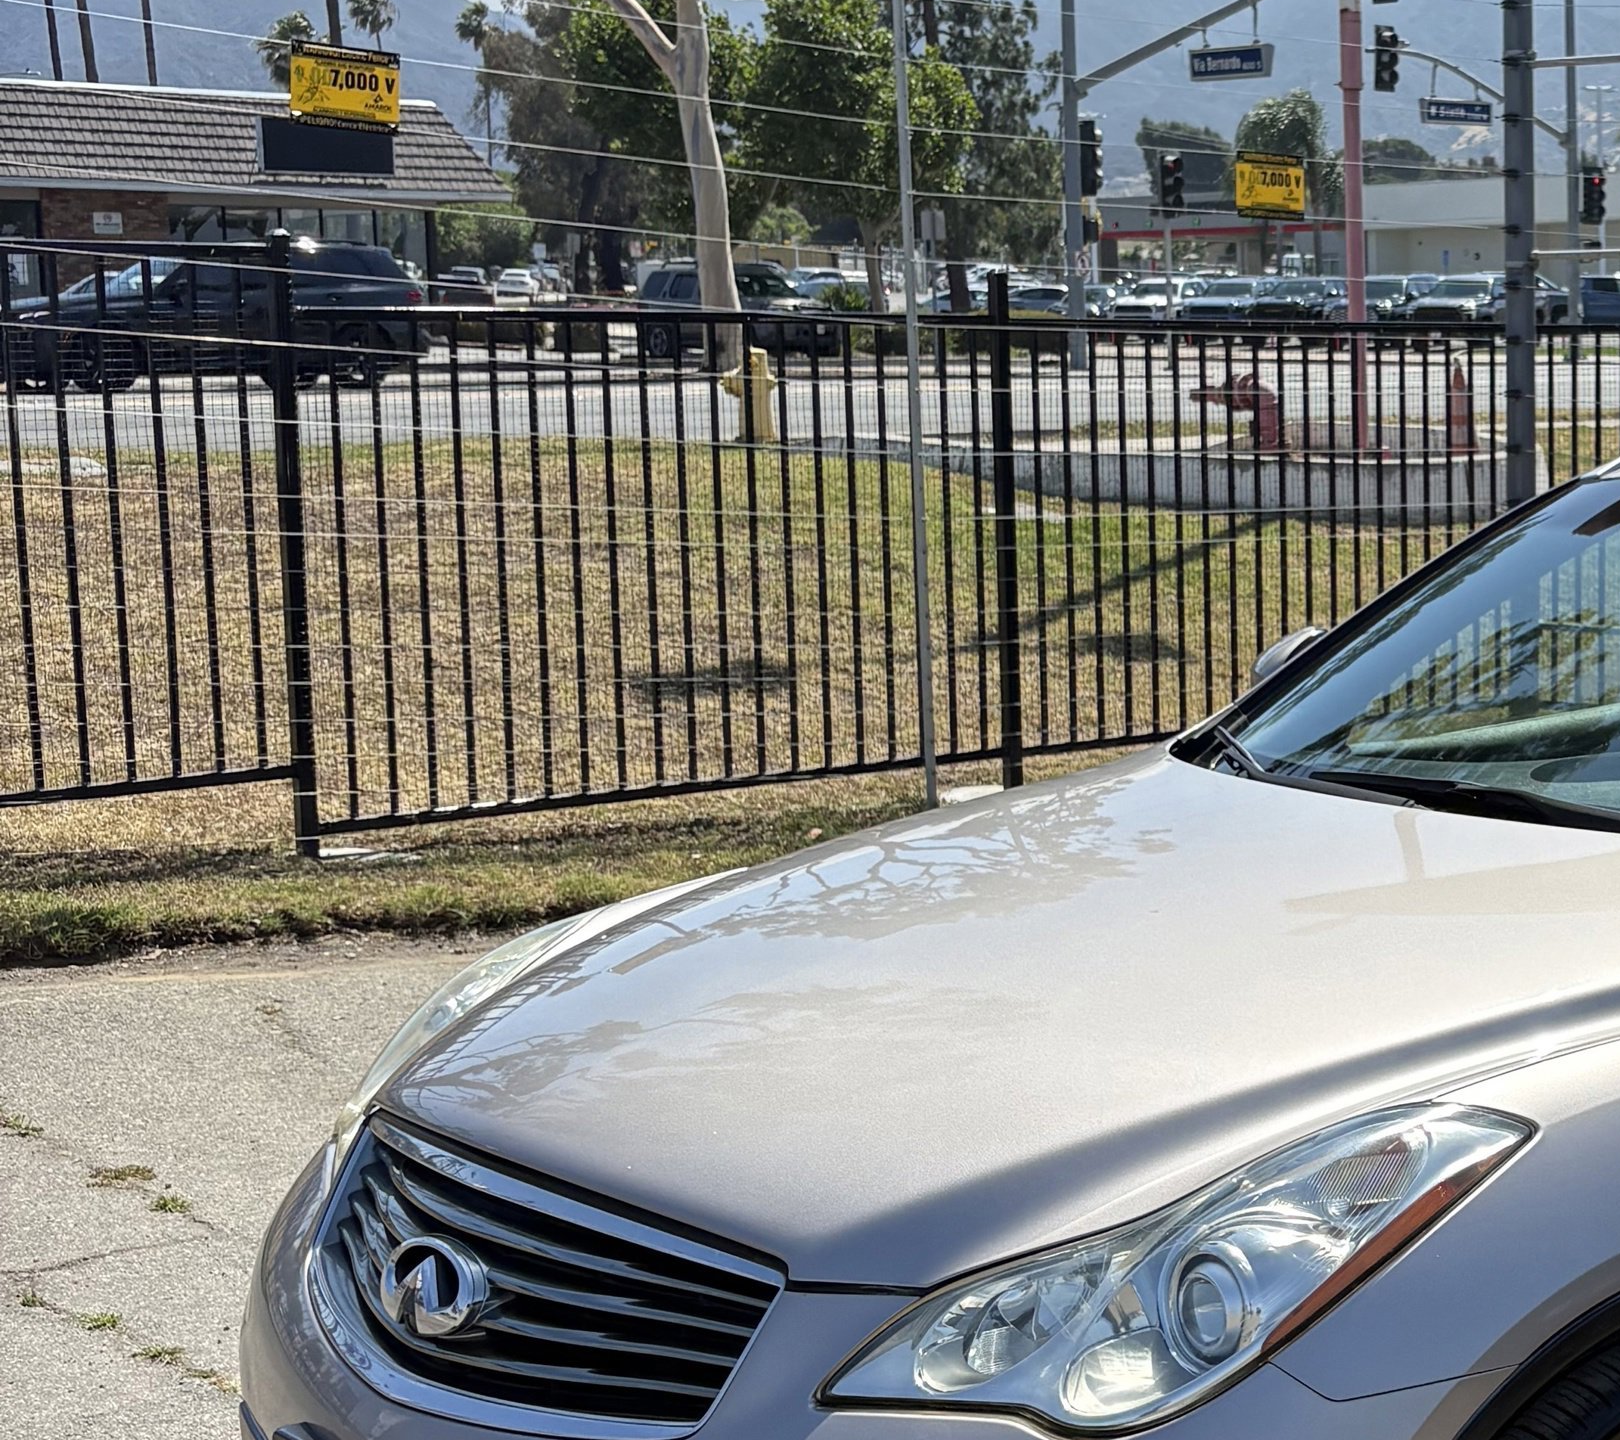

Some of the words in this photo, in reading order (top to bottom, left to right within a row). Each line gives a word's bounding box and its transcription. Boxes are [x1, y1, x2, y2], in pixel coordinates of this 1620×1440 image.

[330, 69, 379, 93] 7,000
[385, 77, 396, 95] V
[1261, 171, 1291, 188] 7,000
[1294, 175, 1301, 189] V
